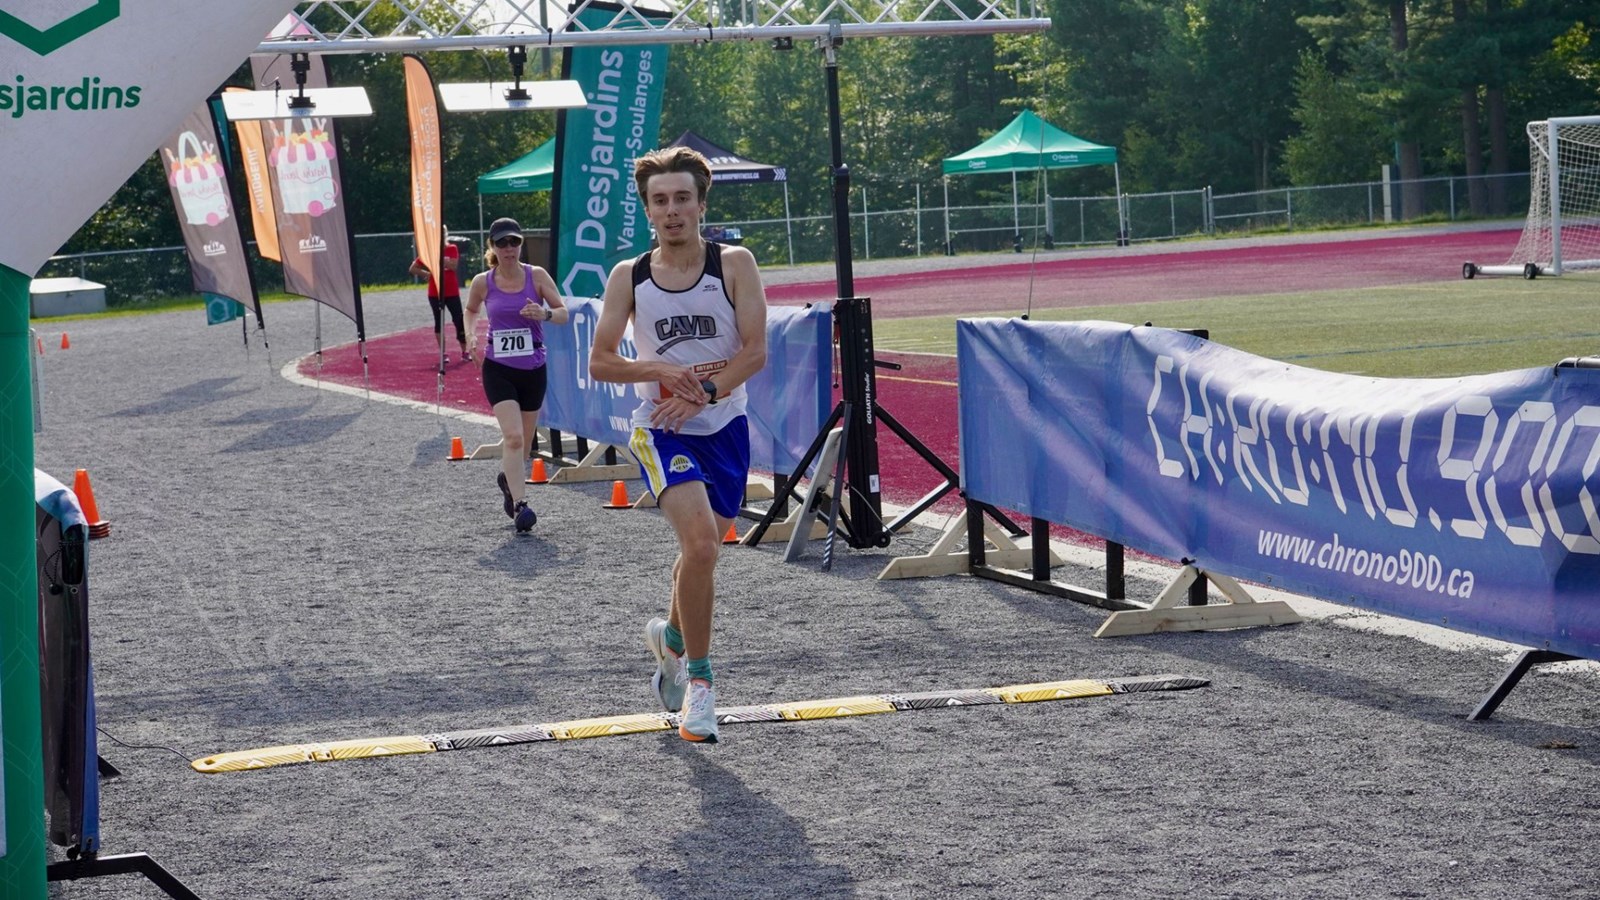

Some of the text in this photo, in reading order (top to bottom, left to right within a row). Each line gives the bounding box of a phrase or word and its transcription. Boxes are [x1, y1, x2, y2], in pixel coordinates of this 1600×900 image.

[575, 50, 624, 250] Desjardins
[501, 335, 525, 351] 270
[655, 315, 717, 341] CAVD
[1258, 529, 1475, 599] www.chrono900.ca
